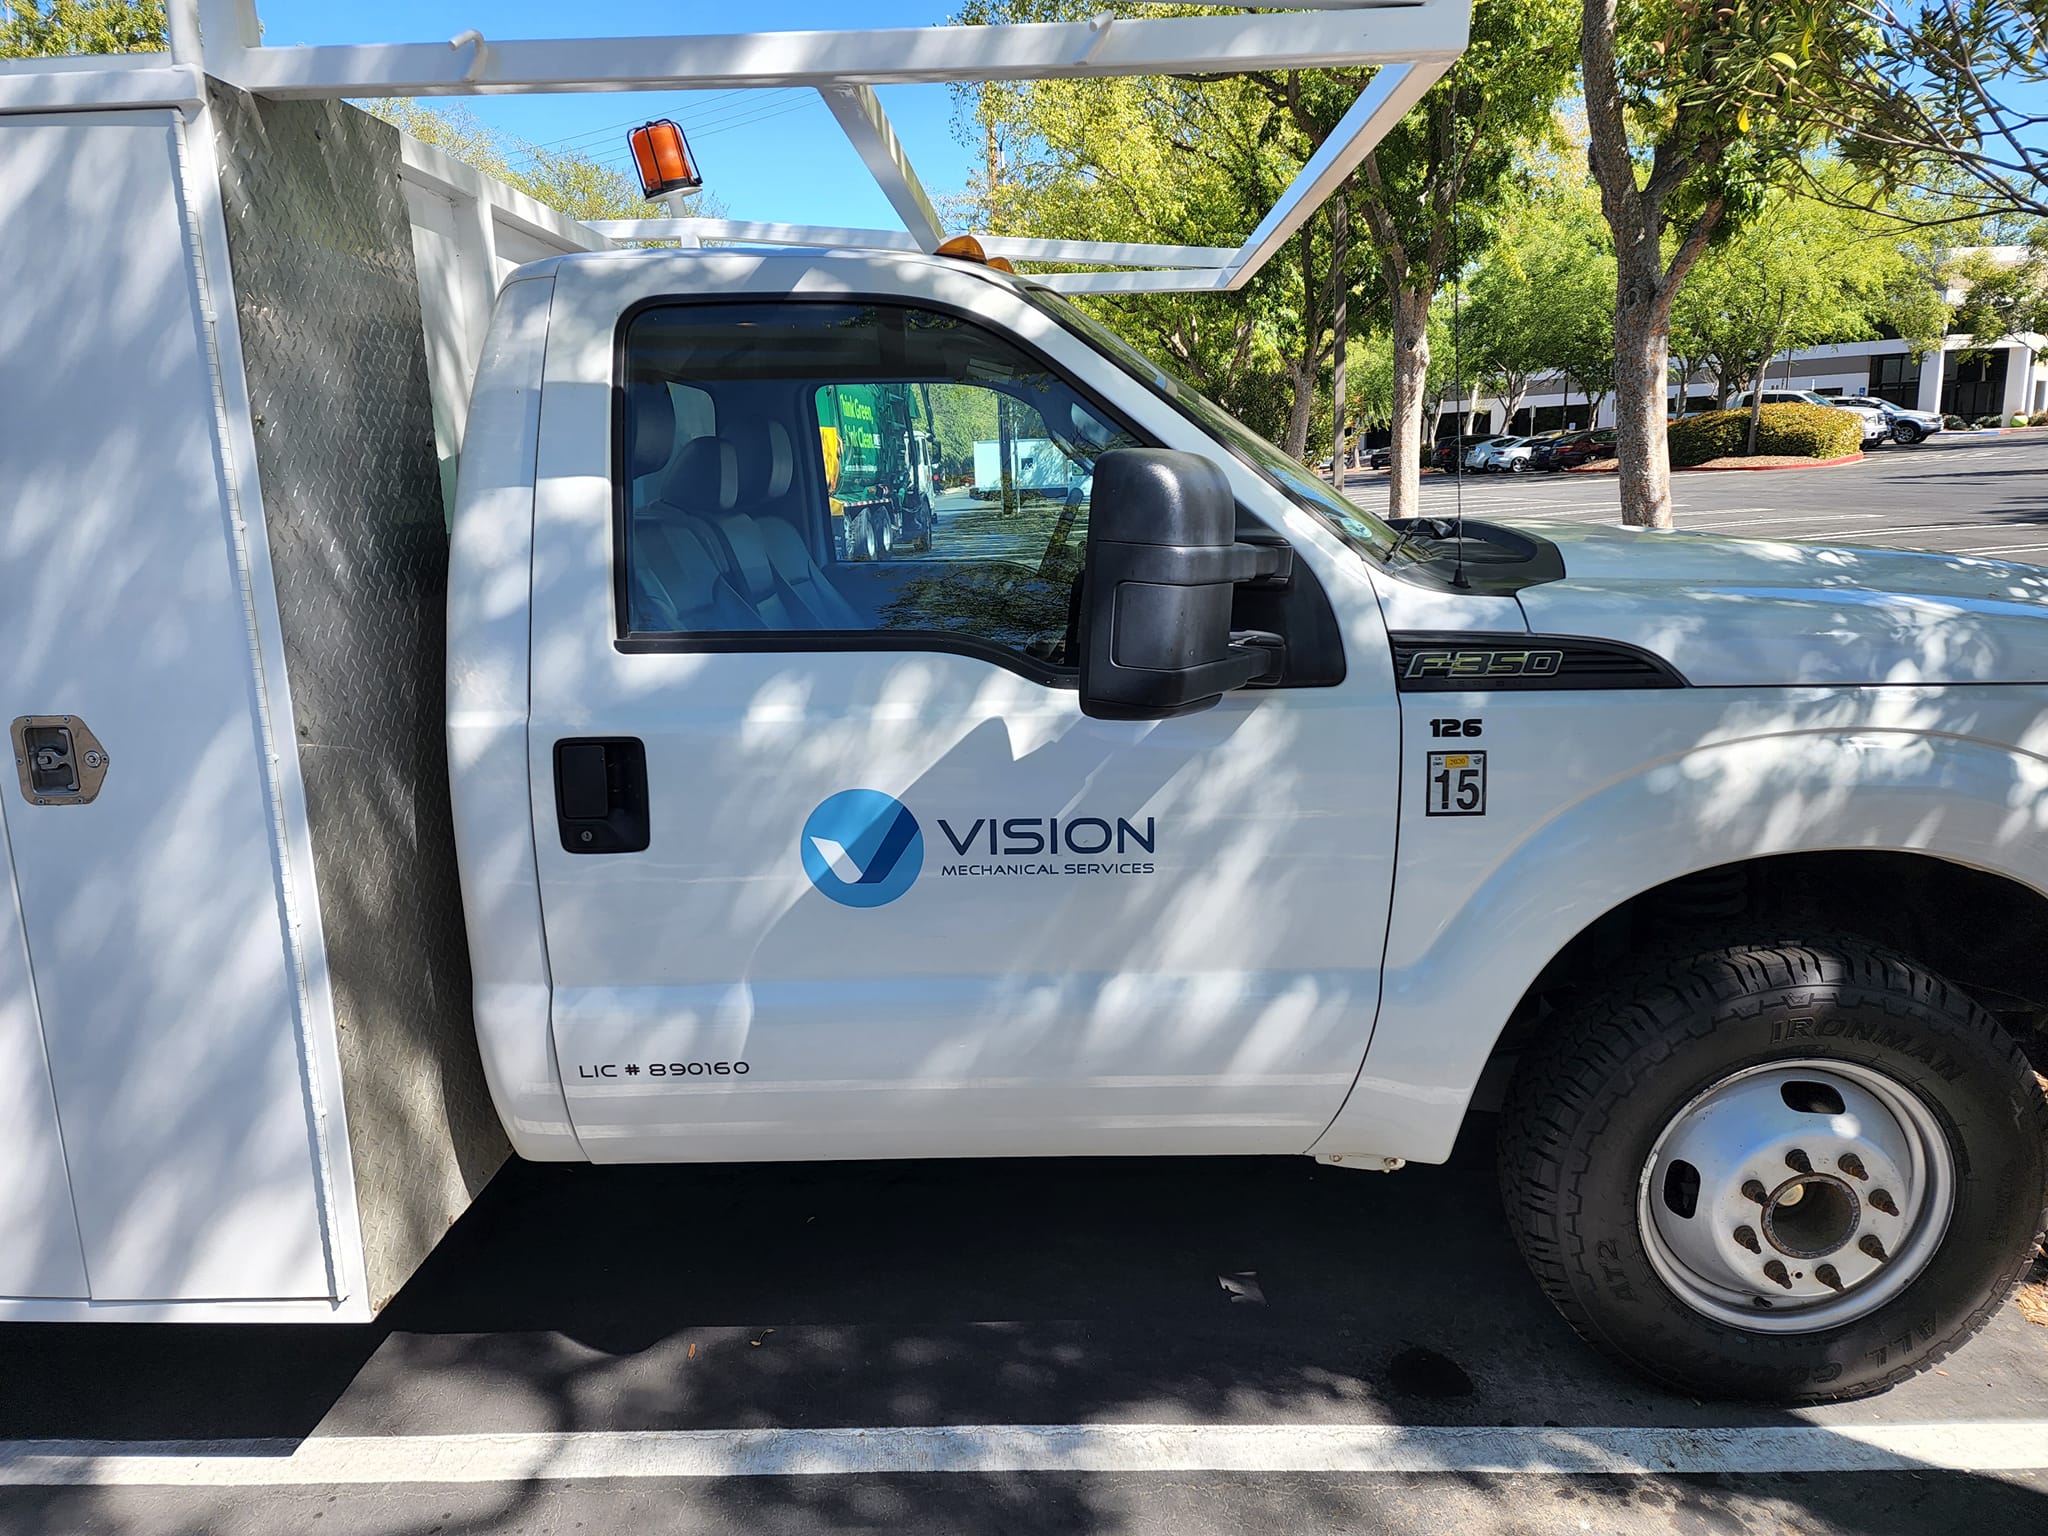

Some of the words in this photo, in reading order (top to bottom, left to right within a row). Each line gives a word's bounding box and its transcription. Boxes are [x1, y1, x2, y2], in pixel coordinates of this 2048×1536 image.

[1429, 718, 1482, 738] 126
[1434, 769, 1480, 810] 15
[936, 816, 1155, 855] VISION
[941, 863, 1059, 876] MECHANICAL
[1064, 863, 1155, 875] SERVICES
[1770, 1017, 1966, 1083] IRONMAN
[579, 1065, 618, 1078] LIC
[624, 1064, 640, 1076] #
[649, 1061, 750, 1077] 890160
